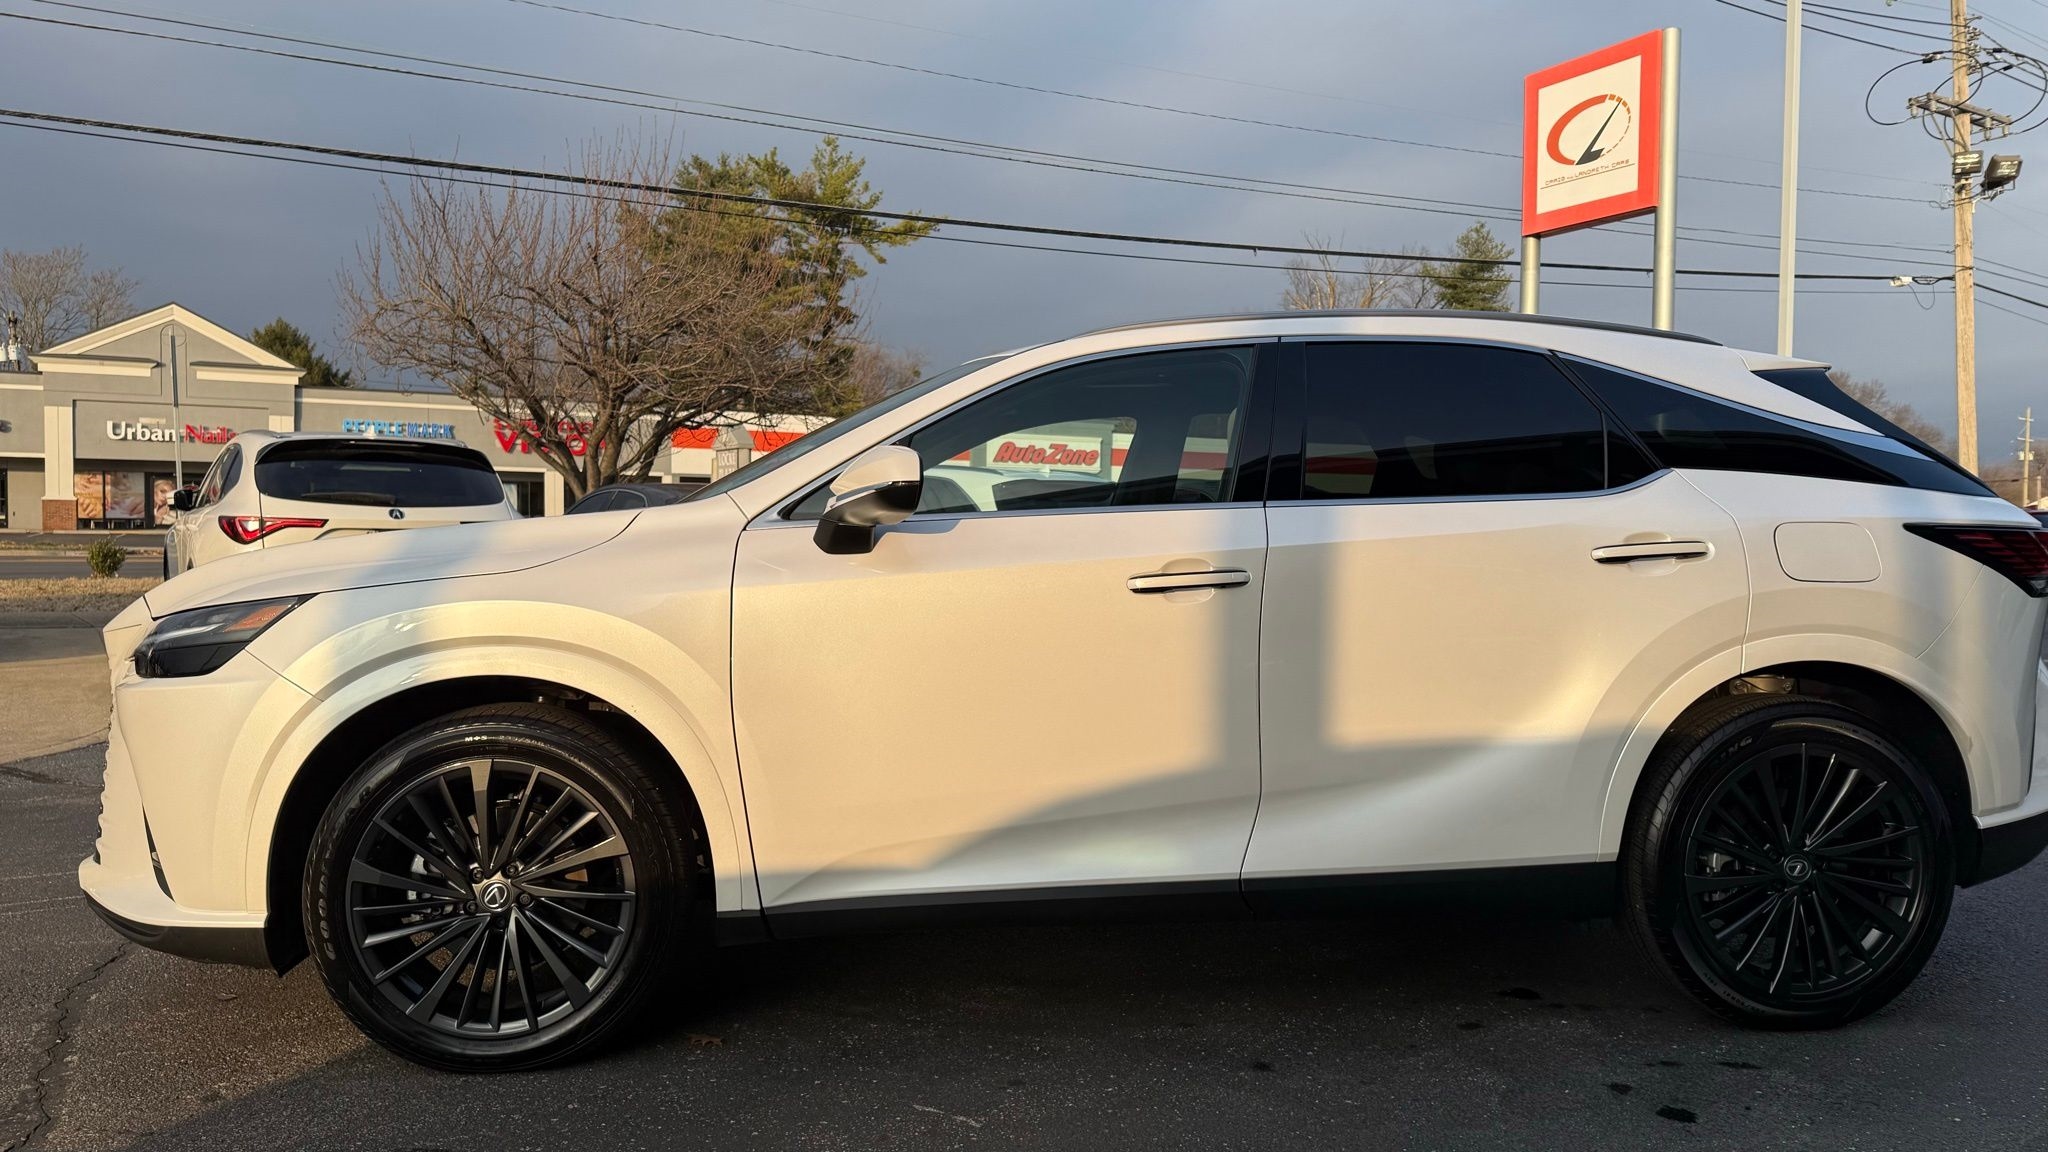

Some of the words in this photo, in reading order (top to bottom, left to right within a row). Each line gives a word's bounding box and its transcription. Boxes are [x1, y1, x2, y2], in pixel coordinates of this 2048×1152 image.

[106, 420, 176, 442] Urban
[407, 422, 454, 439] MARK
[993, 441, 1099, 466] AutoZone
